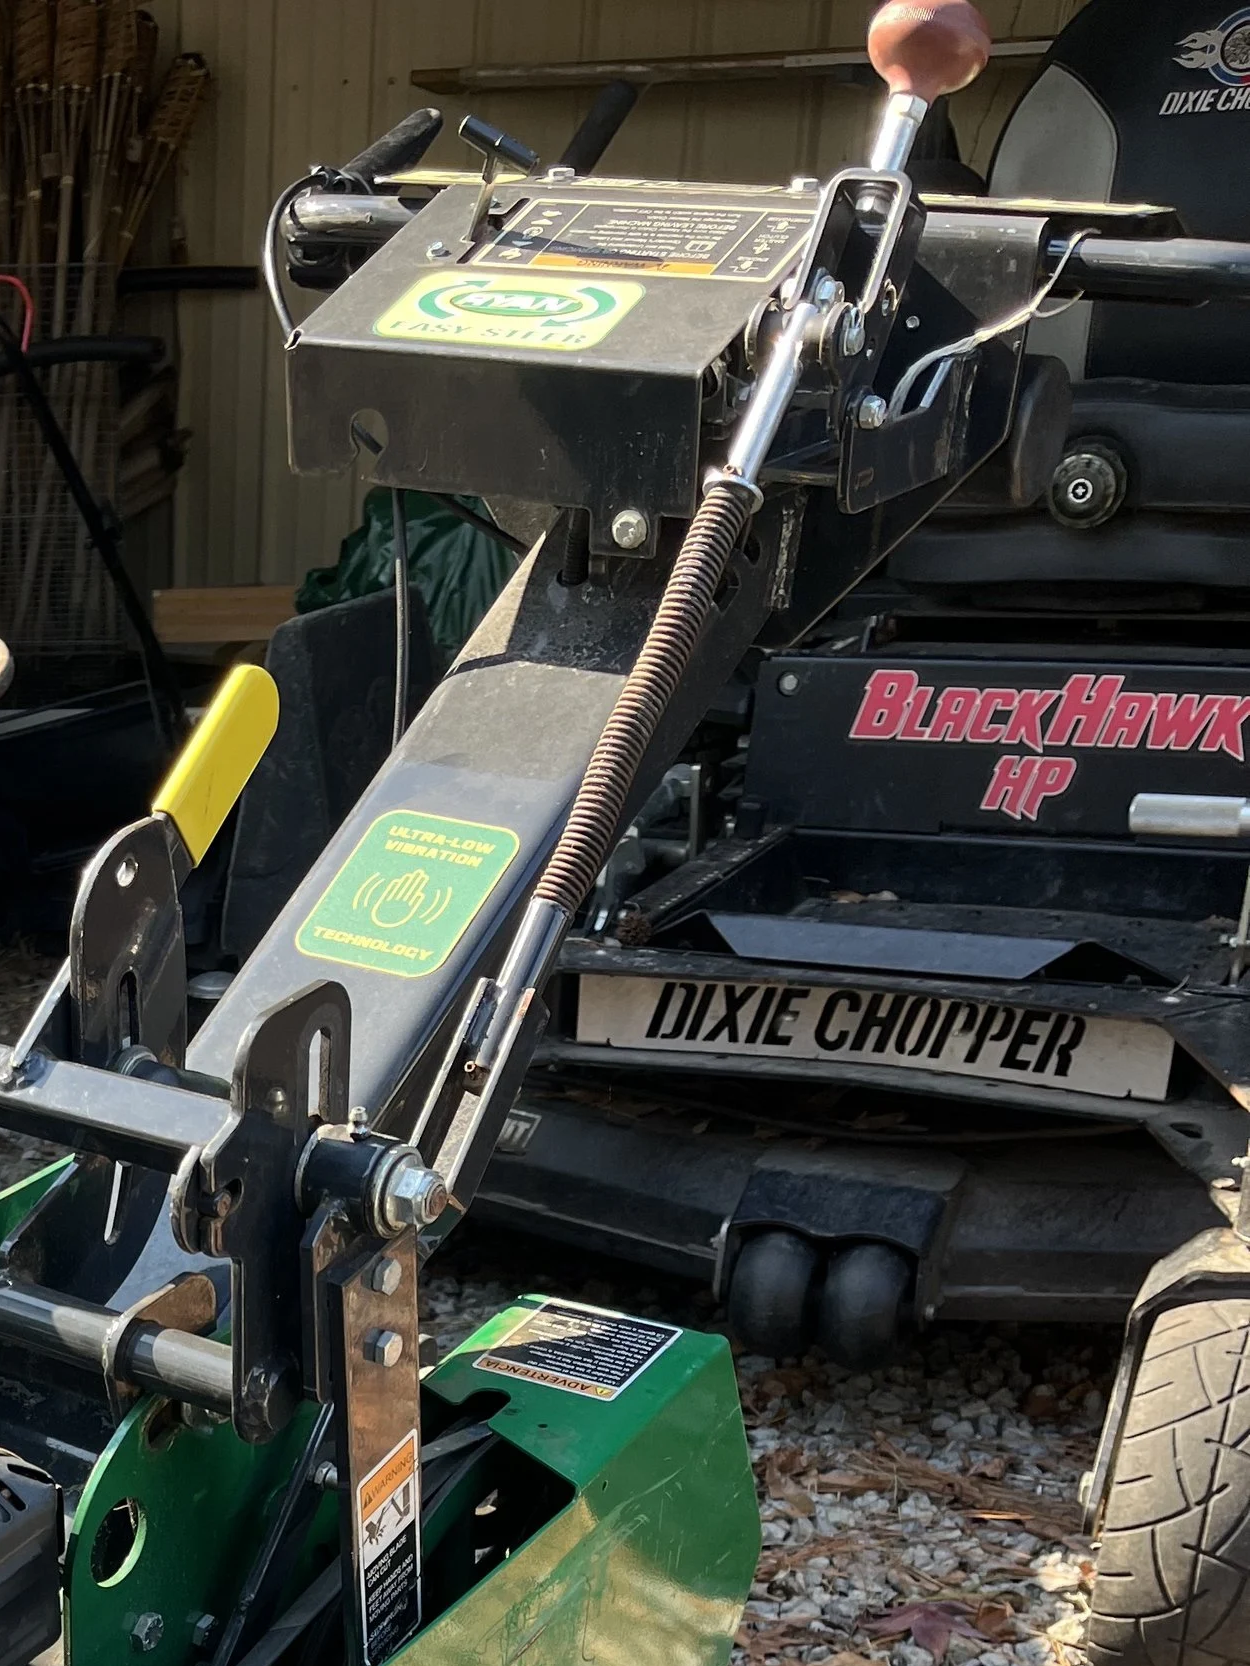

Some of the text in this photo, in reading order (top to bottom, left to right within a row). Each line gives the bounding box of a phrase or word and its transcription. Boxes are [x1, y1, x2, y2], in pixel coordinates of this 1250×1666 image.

[1158, 88, 1220, 116] DIXIE
[666, 251, 711, 259] BEFORE
[458, 291, 571, 313] RYAN
[391, 319, 589, 346] EASY STEER
[979, 755, 1078, 822] HP
[384, 838, 484, 868] VIBRATION
[388, 824, 497, 855] ULTRA-LOW
[312, 925, 435, 961] TECHNOLOGY
[644, 981, 1087, 1078] DIXIE CHOPPER
[482, 1359, 592, 1391] ADVERTENCIA
[371, 1451, 414, 1497] WARNING
[389, 1532, 406, 1558] BLADE
[367, 1557, 391, 1589] CAN CUT
[382, 1564, 401, 1590] HANDS
[401, 1551, 413, 1570] AND
[368, 1561, 413, 1614] FEET AWAY FROM
[369, 1595, 390, 1623] MOVING
[390, 1577, 407, 1602] PARTS
